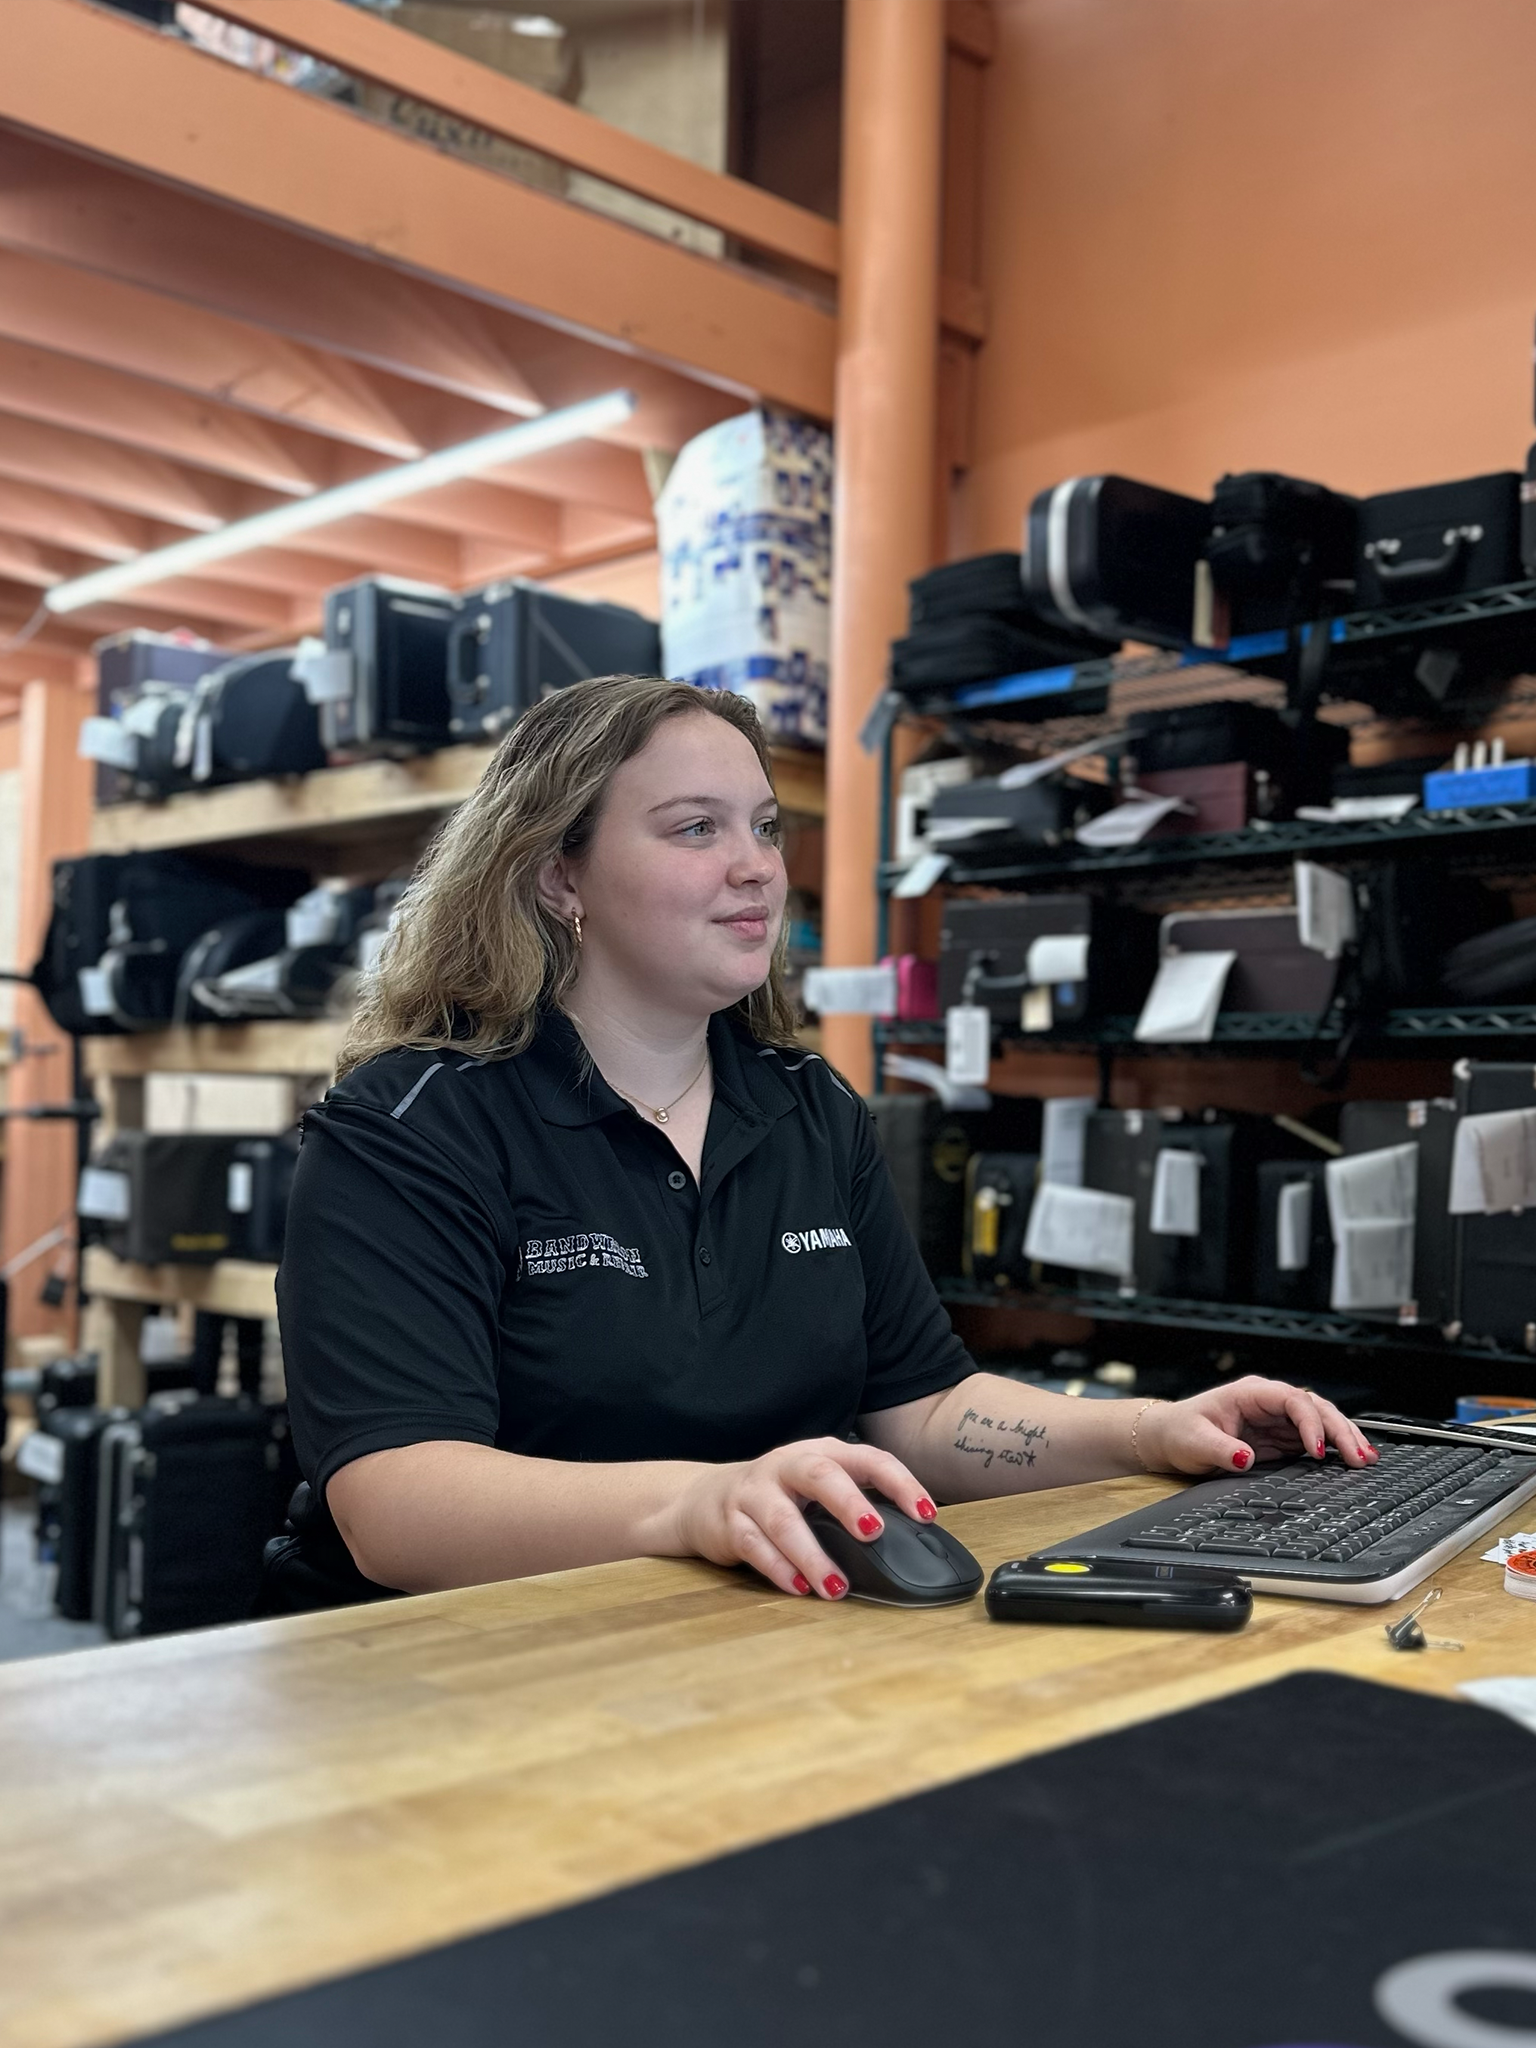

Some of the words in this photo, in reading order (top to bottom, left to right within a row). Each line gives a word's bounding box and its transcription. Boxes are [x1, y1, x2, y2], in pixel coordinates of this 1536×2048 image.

[798, 1228, 852, 1252] YAMAHA
[527, 1253, 587, 1276] MUSIC
[589, 1253, 601, 1266] &
[997, 1421, 1007, 1431] a
